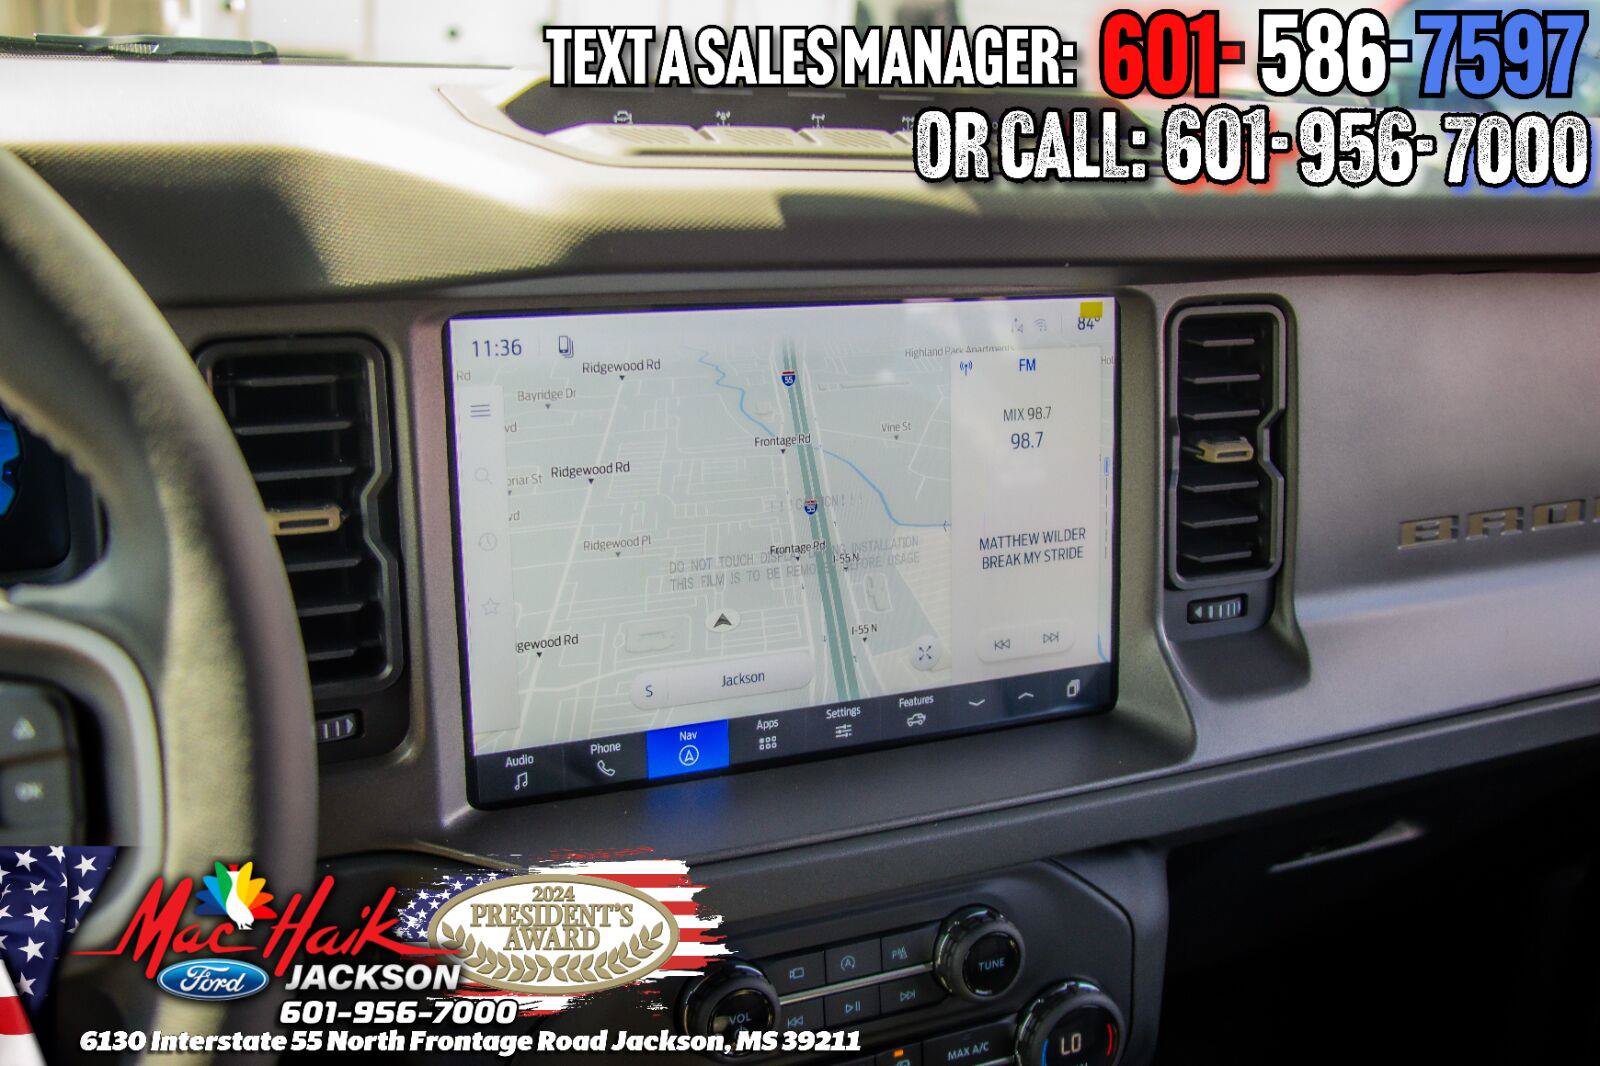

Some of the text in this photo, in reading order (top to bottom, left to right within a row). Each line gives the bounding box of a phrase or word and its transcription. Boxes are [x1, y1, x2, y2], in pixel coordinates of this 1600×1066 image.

[471, 338, 522, 357] 11:36
[904, 346, 944, 359] Highland
[582, 359, 661, 375] Ridgewood Rd
[1019, 358, 1036, 371] FM
[456, 370, 472, 381] Rd
[517, 388, 564, 402] Bayridge
[1003, 405, 1052, 422] MIX 98.7
[881, 421, 912, 433] Vine St
[754, 433, 811, 448] Frontage Rd
[1010, 431, 1044, 449] 98.7
[551, 461, 631, 479] Ridgewood Rd
[531, 473, 543, 485] St
[1399, 498, 1600, 549] BRO
[583, 534, 652, 551] Ridgewood Pl
[979, 527, 1086, 551] MATTHEW WILDER
[770, 543, 812, 555] Frontage
[813, 540, 827, 551] Rd
[669, 560, 685, 575] DO
[691, 556, 714, 572] NOT
[719, 552, 754, 569] TOUCH
[982, 546, 1084, 570] BREAK MY STRIDE
[670, 576, 694, 591] THIS
[701, 572, 725, 588] FILM
[730, 570, 741, 585] IS
[747, 568, 760, 583] TO
[767, 566, 781, 580] BE
[851, 622, 878, 635] I-55 N
[516, 633, 579, 654] gewood Rd
[721, 670, 766, 688] Jackson
[644, 684, 654, 698] S
[899, 693, 935, 709] Features
[826, 705, 862, 721] Settings
[757, 717, 779, 732] Apps
[679, 730, 698, 742] Nav
[590, 741, 621, 756] Phone
[505, 753, 534, 769] Audio
[978, 958, 1005, 972] TUNE
[728, 1011, 752, 1025] VOL
[947, 1041, 990, 1061] MAX A/C
[1061, 1032, 1082, 1056] LO
